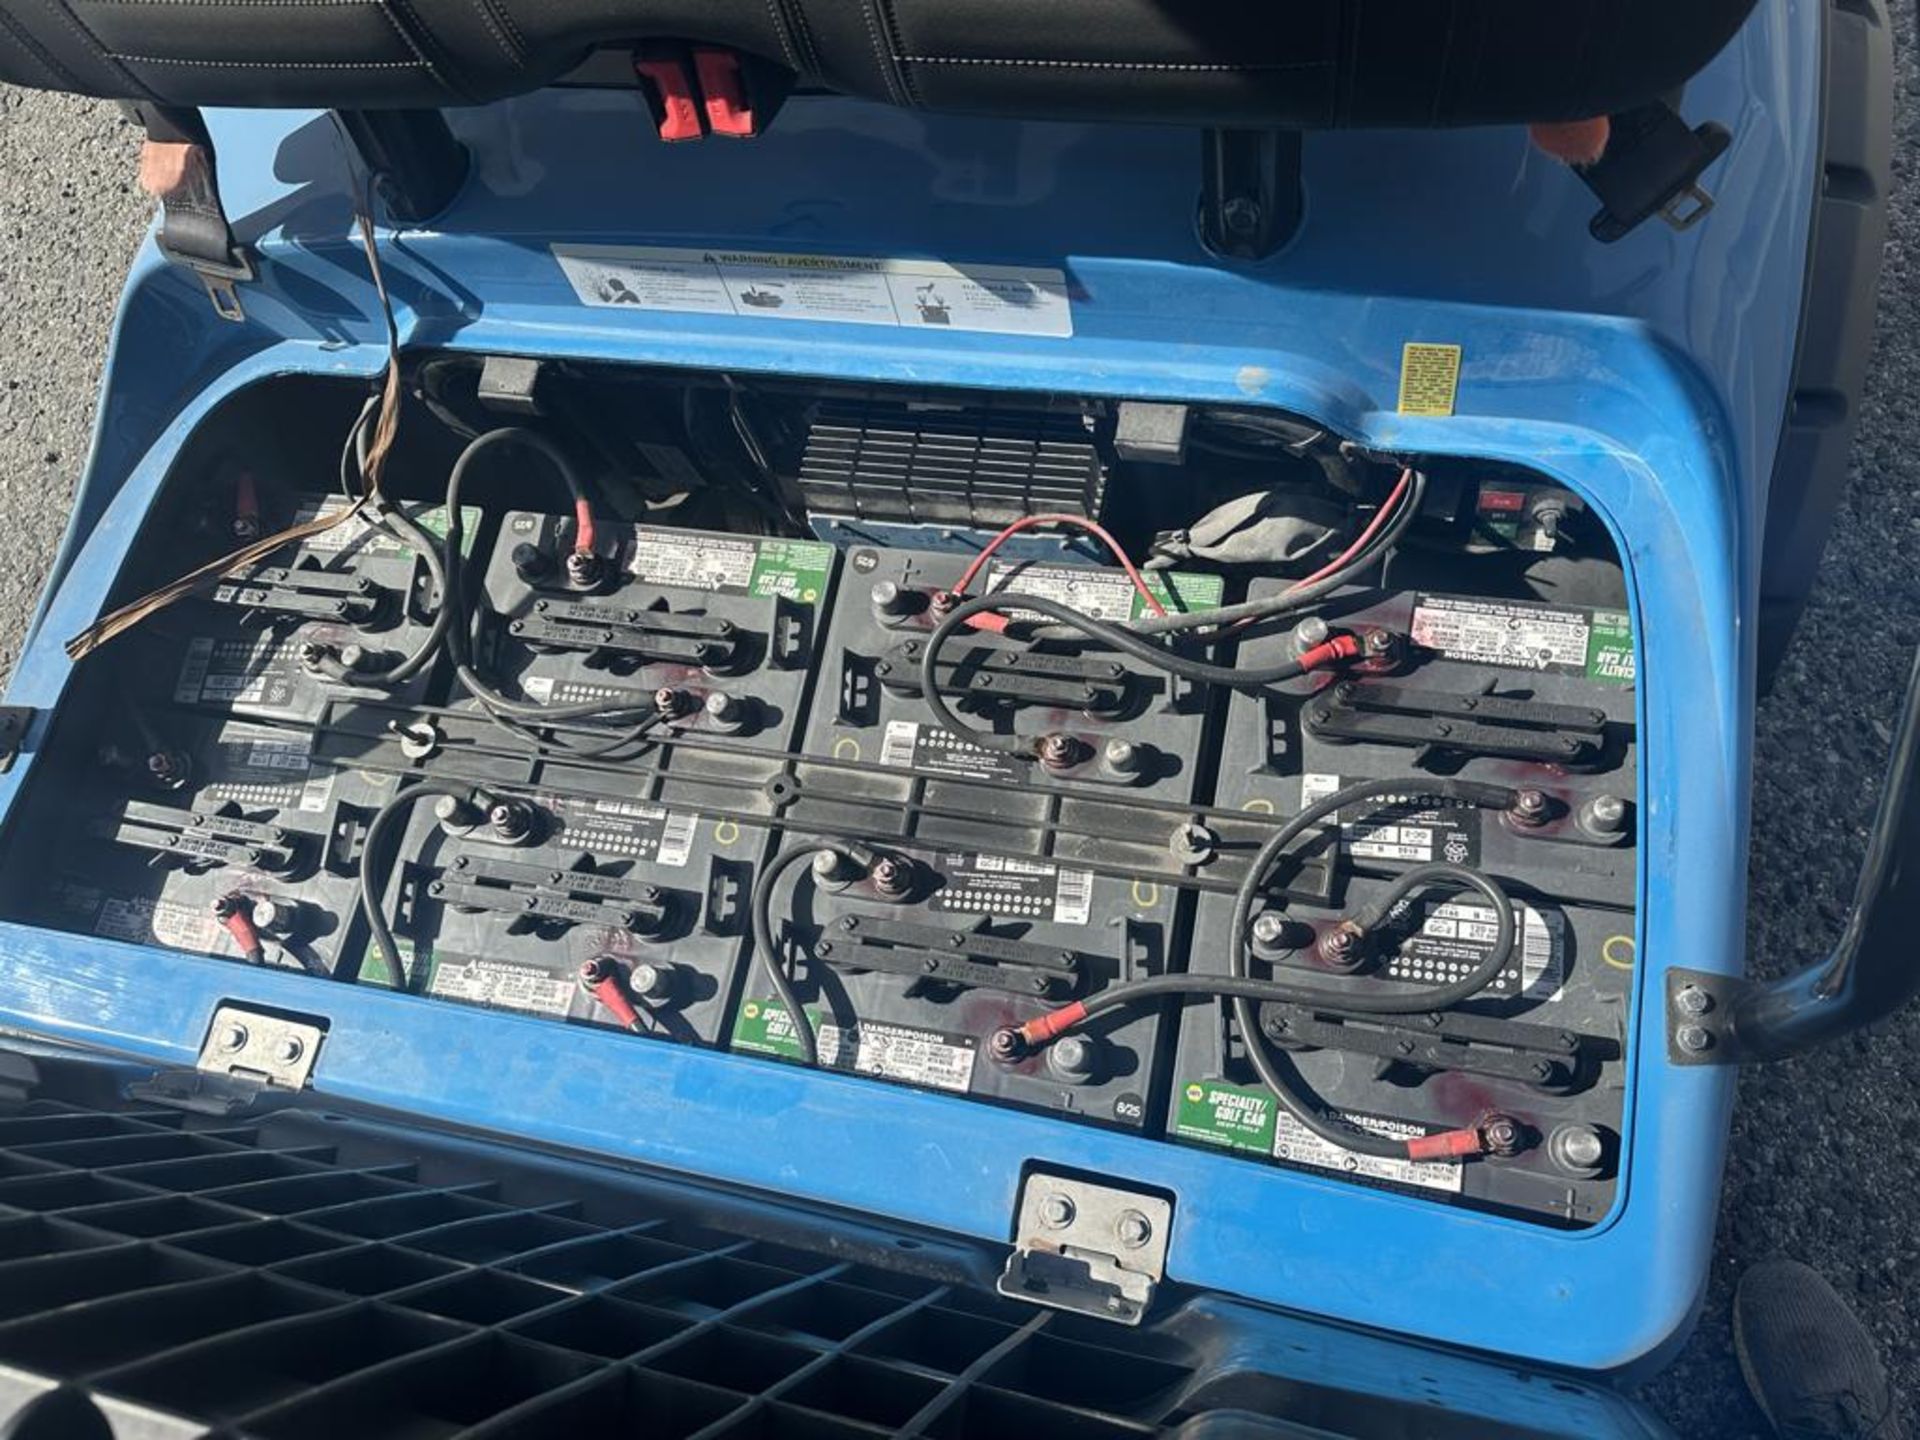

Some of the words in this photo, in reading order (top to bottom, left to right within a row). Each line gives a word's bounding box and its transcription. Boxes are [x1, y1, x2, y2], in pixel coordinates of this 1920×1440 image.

[719, 254, 777, 266] WARNING
[1444, 650, 1540, 668] DANGER/POISON
[863, 1022, 944, 1044] DANGER/POISON
[1116, 1101, 1141, 1118] 8/25
[1208, 1090, 1269, 1113] SPECIALTY/
[1214, 1105, 1242, 1122] GOLF
[1242, 1111, 1267, 1128] CAR
[1328, 1110, 1426, 1137] DANGER/POISON
